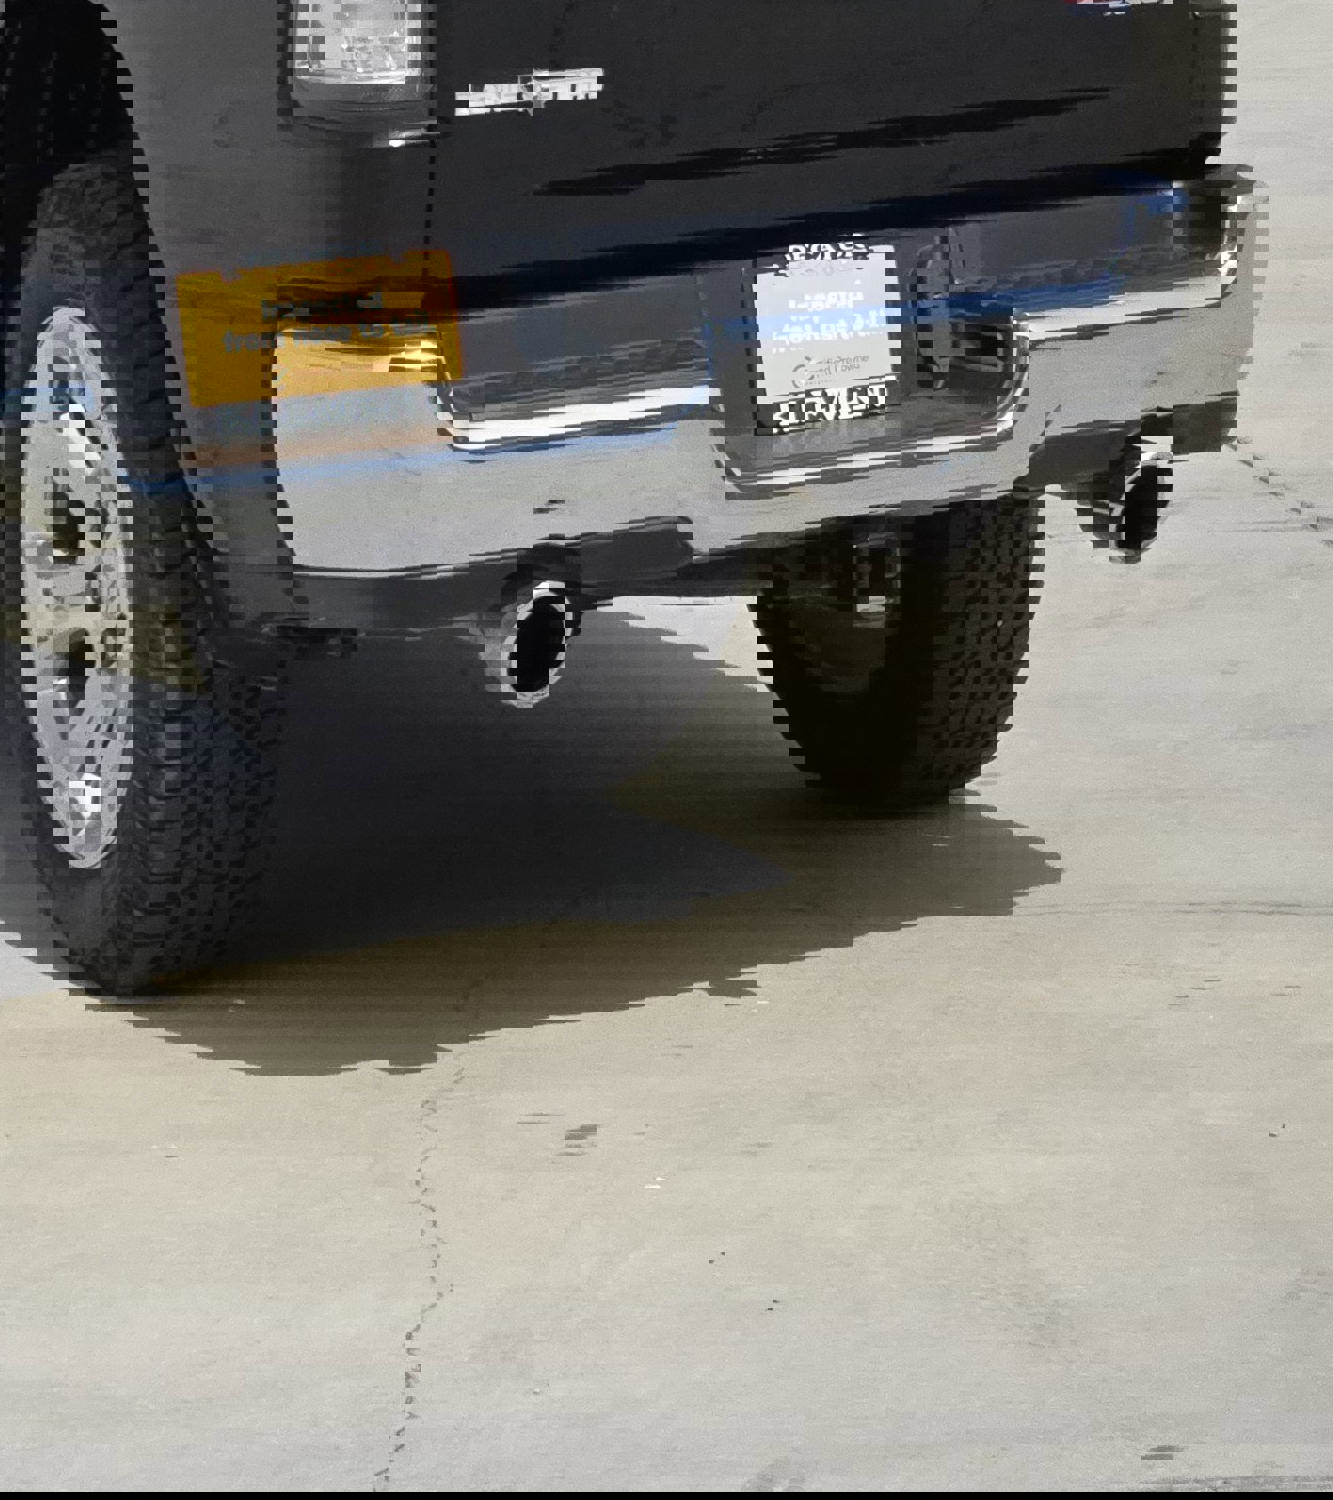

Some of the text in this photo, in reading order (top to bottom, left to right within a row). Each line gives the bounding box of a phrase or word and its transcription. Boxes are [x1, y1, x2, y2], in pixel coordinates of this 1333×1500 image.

[241, 241, 385, 270] DECATUR
[261, 289, 383, 322] Inspected
[222, 310, 437, 354] from nose to tail.
[288, 363, 335, 380] Certified
[215, 382, 450, 436] KLEMENT
